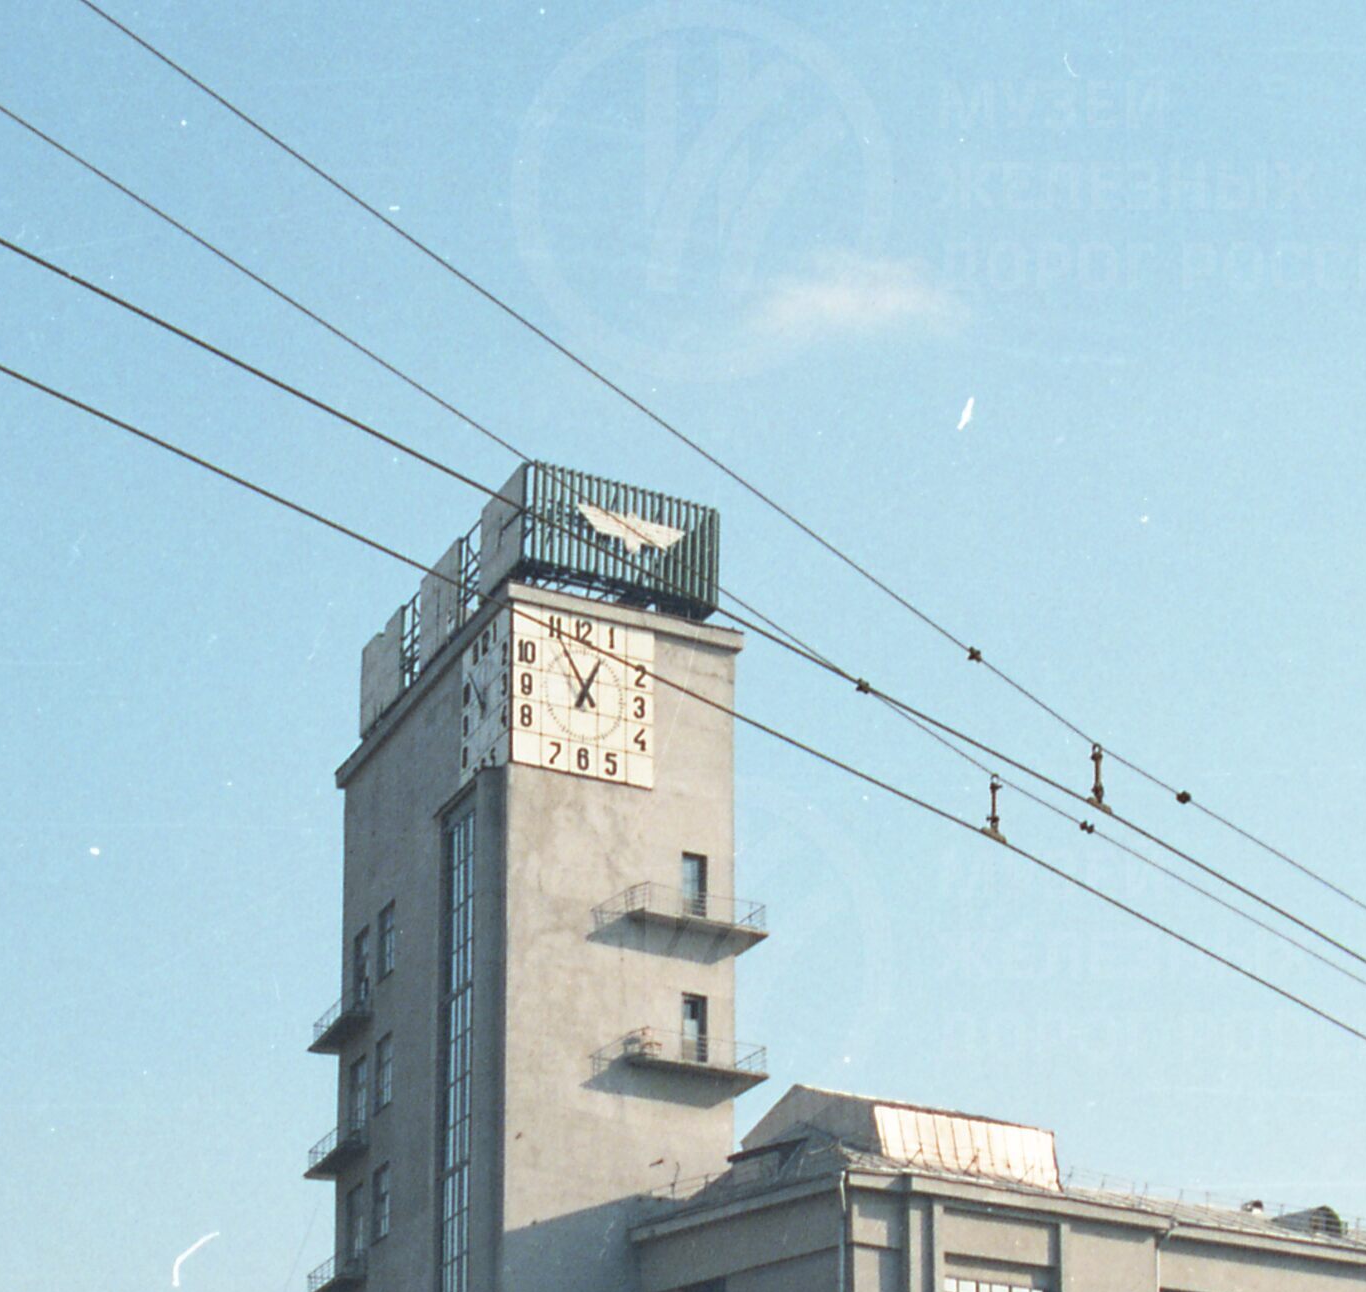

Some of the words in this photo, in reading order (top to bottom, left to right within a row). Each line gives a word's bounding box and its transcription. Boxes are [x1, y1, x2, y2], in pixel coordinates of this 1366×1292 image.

[549, 616, 561, 640] 11
[576, 620, 592, 645] 12
[608, 627, 615, 649] 1
[518, 641, 536, 664] 10
[520, 673, 533, 696] 9
[635, 664, 647, 688] 2
[520, 704, 533, 728] 8
[634, 696, 646, 719] 3
[634, 727, 647, 752] 4
[549, 742, 561, 765] 7
[577, 748, 589, 771] 6
[605, 752, 618, 776] 5
